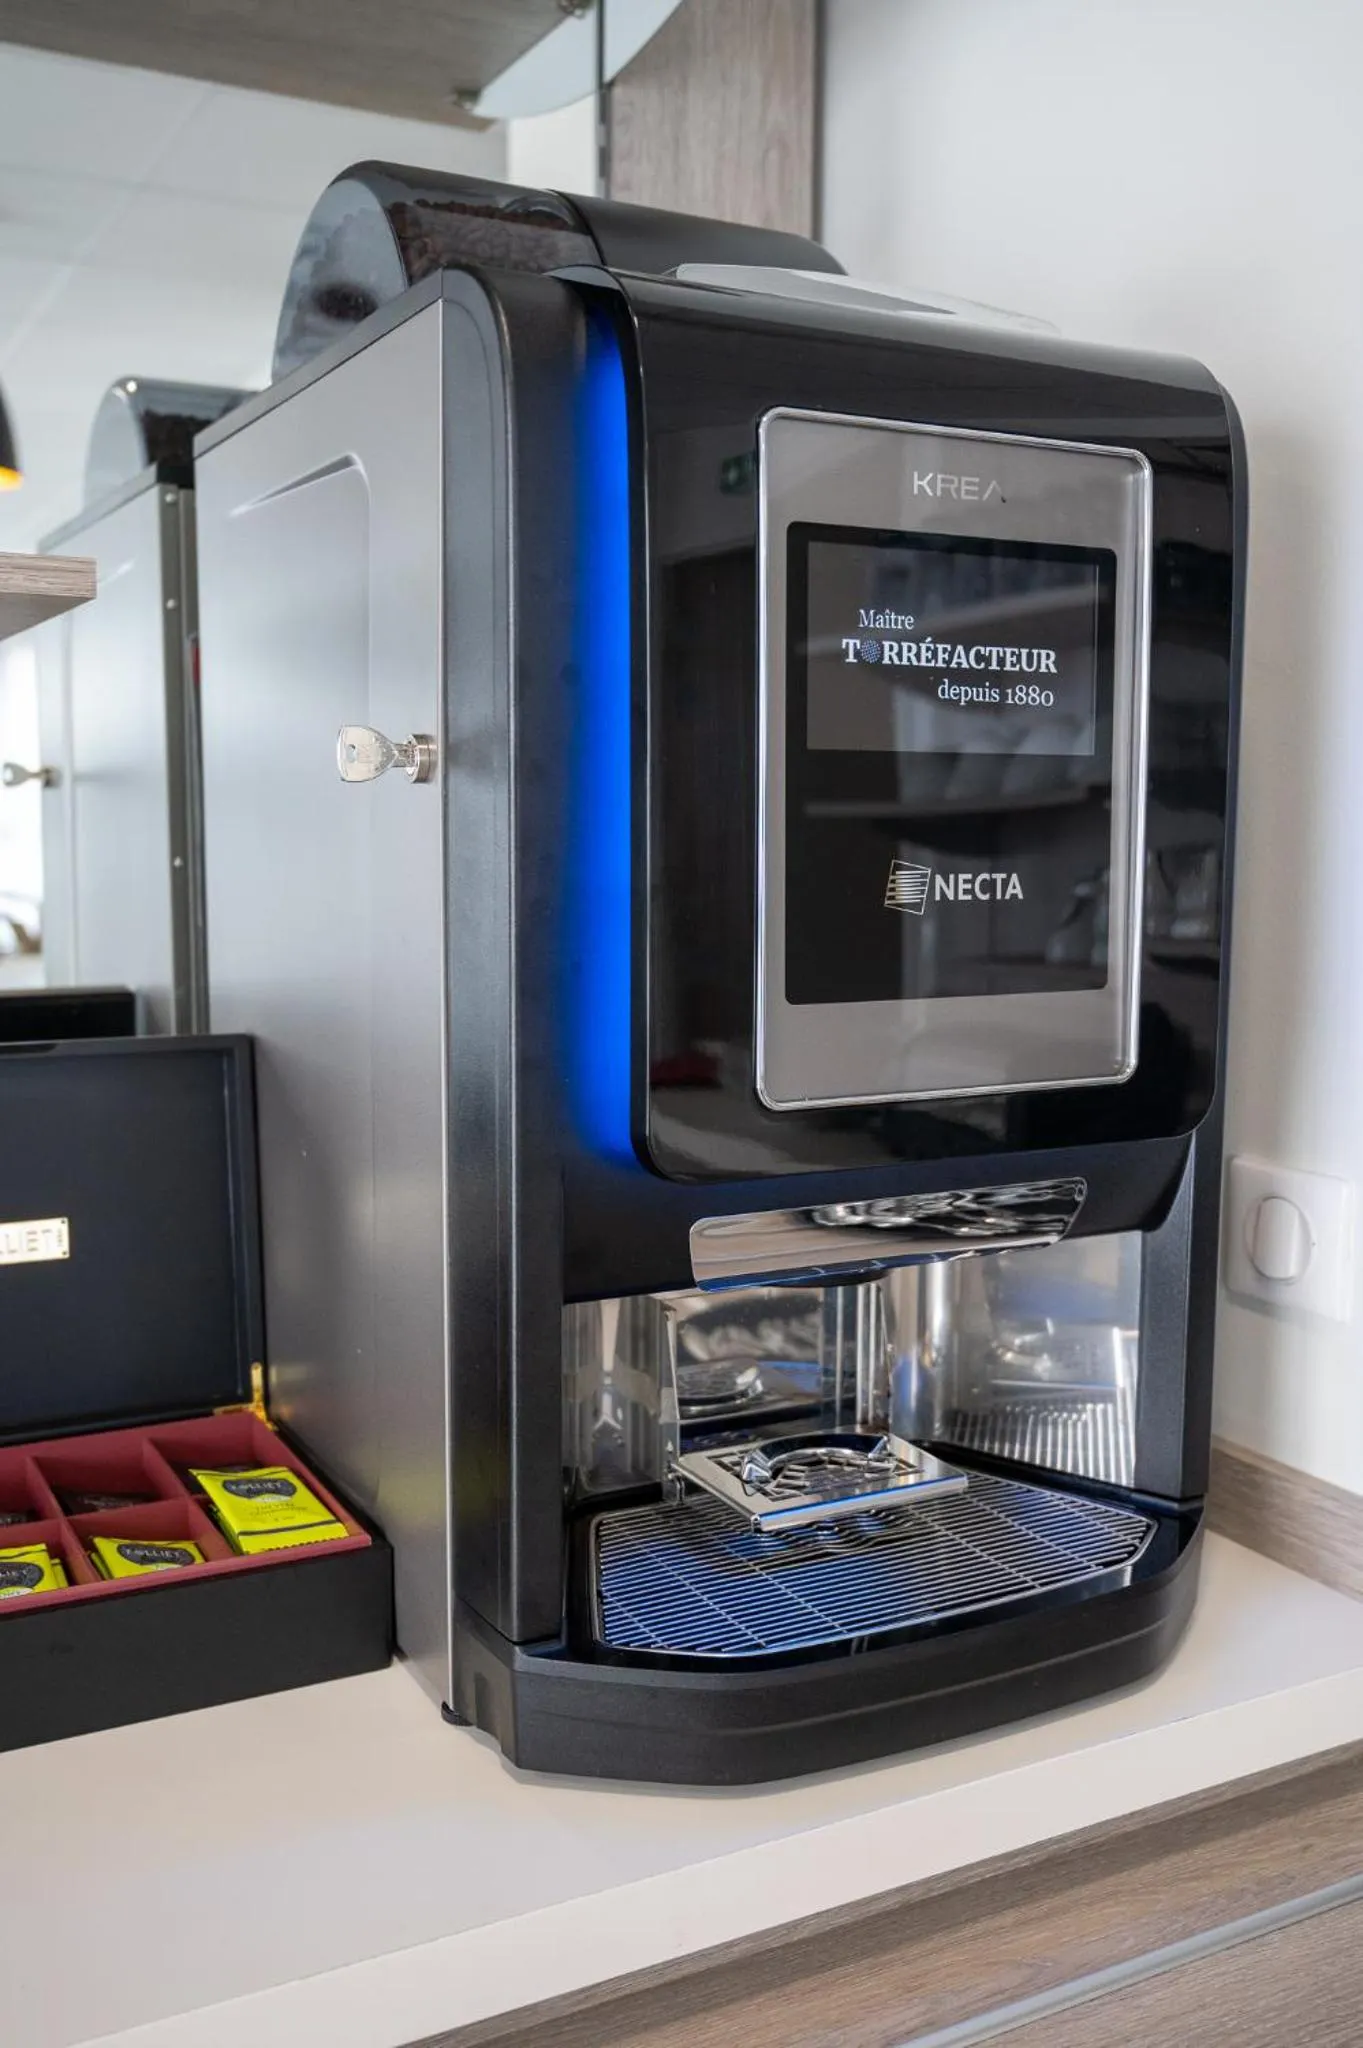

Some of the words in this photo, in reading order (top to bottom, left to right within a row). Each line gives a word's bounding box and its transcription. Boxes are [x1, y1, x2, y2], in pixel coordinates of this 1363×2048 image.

[913, 471, 1005, 501] KREA
[858, 608, 915, 630] Maître
[841, 636, 1058, 673] TORRÉFACTEUR
[937, 678, 1000, 705] depuis
[1005, 684, 1054, 707] 1880
[934, 873, 1024, 901] NECTA
